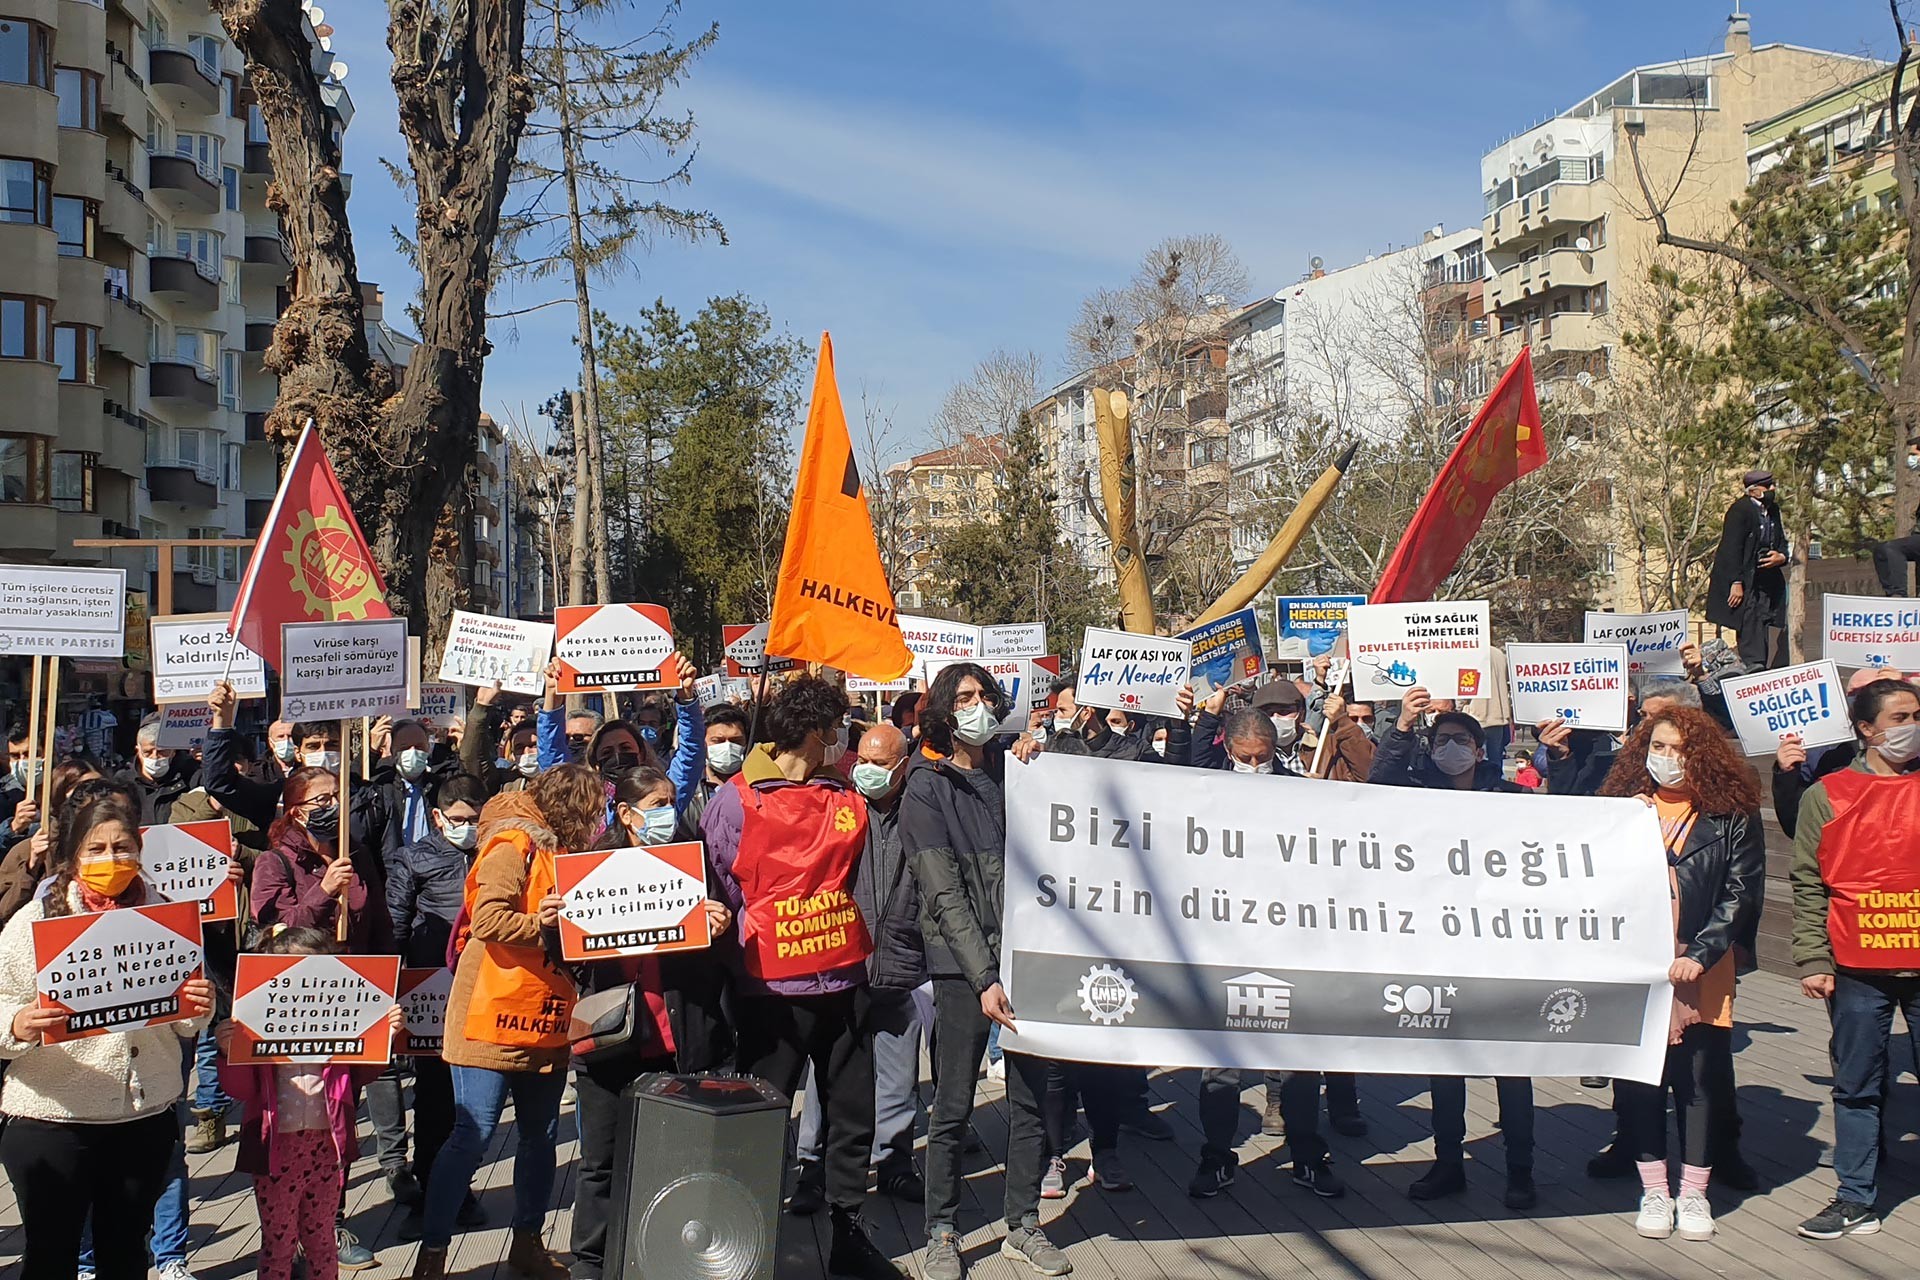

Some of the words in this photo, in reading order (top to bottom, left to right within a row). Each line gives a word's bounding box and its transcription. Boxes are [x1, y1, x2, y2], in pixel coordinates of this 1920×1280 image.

[303, 538, 367, 590] EMEP
[1, 582, 26, 592] Tüm
[28, 582, 68, 594] işçilere
[71, 584, 115, 596] ücretsiz
[3, 593, 23, 603] izin
[26, 595, 82, 607] sağlansın,
[84, 597, 111, 608] işten
[0, 606, 43, 616] atmalar
[45, 607, 114, 618] yasaklansın!
[1405, 613, 1431, 624] TÜM
[1435, 612, 1478, 624] SAĞLIK
[1832, 612, 1894, 628] HERKES
[1897, 610, 1920, 628] İÇİ
[482, 620, 517, 632] PARASIZ
[1190, 630, 1209, 643] KISA
[1210, 618, 1242, 636] SÜREDE
[1289, 619, 1334, 629] ÜCRETSİZ
[1408, 625, 1479, 637] HİZMETLERİ
[1593, 628, 1613, 639] LAF
[1615, 626, 1637, 639] ÇOK
[1640, 624, 1656, 635] AŞI
[1659, 619, 1680, 632] YOK
[179, 632, 211, 646] Kod
[459, 626, 488, 636] SAĞLIK
[489, 629, 526, 642] HİZMETİ!
[940, 631, 974, 645] EĞİTİM
[992, 628, 1035, 637] Sermayeye
[1830, 629, 1884, 643] ÜCRETSİZ
[16, 635, 55, 647] EMEK
[61, 637, 116, 648] PARTİSİ
[313, 636, 350, 649] Virüse
[352, 636, 379, 649] karşı
[477, 640, 513, 652] PARASIZ
[567, 637, 608, 645] Herkes
[738, 639, 757, 647] 128
[1004, 636, 1024, 645] değil
[1359, 638, 1479, 653] DEVLETLEŞTİRİLMELİ
[560, 650, 582, 658] AKP
[588, 649, 616, 657] IBAN
[621, 646, 673, 656] Gönderir
[936, 644, 973, 658] SAĞLIK!
[987, 645, 1016, 654] sağlığa
[1016, 644, 1042, 653] bütçe!
[1091, 648, 1113, 660] LAF
[1115, 649, 1138, 661] ÇOK
[1140, 650, 1158, 662] AŞI
[1161, 650, 1183, 662] YOK
[166, 649, 251, 665] kaldırılsn!
[292, 650, 341, 664] mesafeli
[344, 650, 399, 662] sömürüye
[296, 667, 325, 680] karşı
[327, 665, 342, 676] bir
[345, 662, 395, 676] aradayız!
[993, 661, 1020, 675] DEĞİL
[1084, 662, 1113, 685] Aşı
[1117, 663, 1186, 686] Nerede?
[1515, 662, 1571, 677] PARASIZ
[1574, 657, 1618, 674] EĞİTİM
[177, 679, 209, 689] EMEK
[576, 670, 660, 685] HALKEVLERİ
[1517, 679, 1568, 693] PARASIZ
[1571, 676, 1619, 691] SAĞLIK!
[1735, 676, 1792, 700] SERMAYEYE
[1792, 667, 1824, 685] DEĞİL
[309, 699, 345, 711] EMEK
[351, 694, 400, 708] PARTİSİ
[1749, 687, 1814, 716] SAĞLIĞA
[168, 707, 208, 718] PARASIZ
[1555, 708, 1580, 719] SOL
[1767, 705, 1819, 732] BÜTÇE
[165, 718, 203, 728] PARASIZ
[1049, 802, 1152, 851] Bizi
[1186, 816, 1244, 859] bu
[1276, 826, 1415, 873] virüs
[1447, 838, 1595, 886] değil
[153, 853, 228, 874] sağlığa
[574, 885, 628, 902] Açken
[637, 878, 685, 897] keyif
[566, 906, 603, 922] çayı
[612, 894, 702, 917] içilmiyor!
[1036, 873, 1153, 916] Sizin
[1181, 887, 1416, 934] düzeniniz
[1442, 905, 1625, 941] öldürür
[775, 906, 858, 938] KOMÜNİS
[585, 925, 685, 950] HALKEVLERİ
[777, 926, 848, 959] PARTİSİ
[66, 948, 102, 964] 128
[113, 938, 176, 959] Milyar
[51, 966, 107, 984] Dolar
[117, 950, 199, 974] Nerede?
[269, 977, 291, 989] 39
[301, 976, 366, 989] Liralık
[48, 982, 113, 1002] Damat
[267, 992, 346, 1006] Yevmiye
[356, 989, 381, 1003] İle
[1091, 985, 1126, 1001] EMEP
[1383, 982, 1452, 1015] SOL
[70, 997, 179, 1030] HALKEVLERİ
[265, 1007, 361, 1019] Patronlar
[264, 1021, 359, 1036] Geçinsin!
[1225, 1015, 1289, 1030] halkevleri
[1398, 1013, 1450, 1029] PARTİ
[1549, 1023, 1571, 1034] TKP
[256, 1038, 363, 1055] HALKEVLERİ
